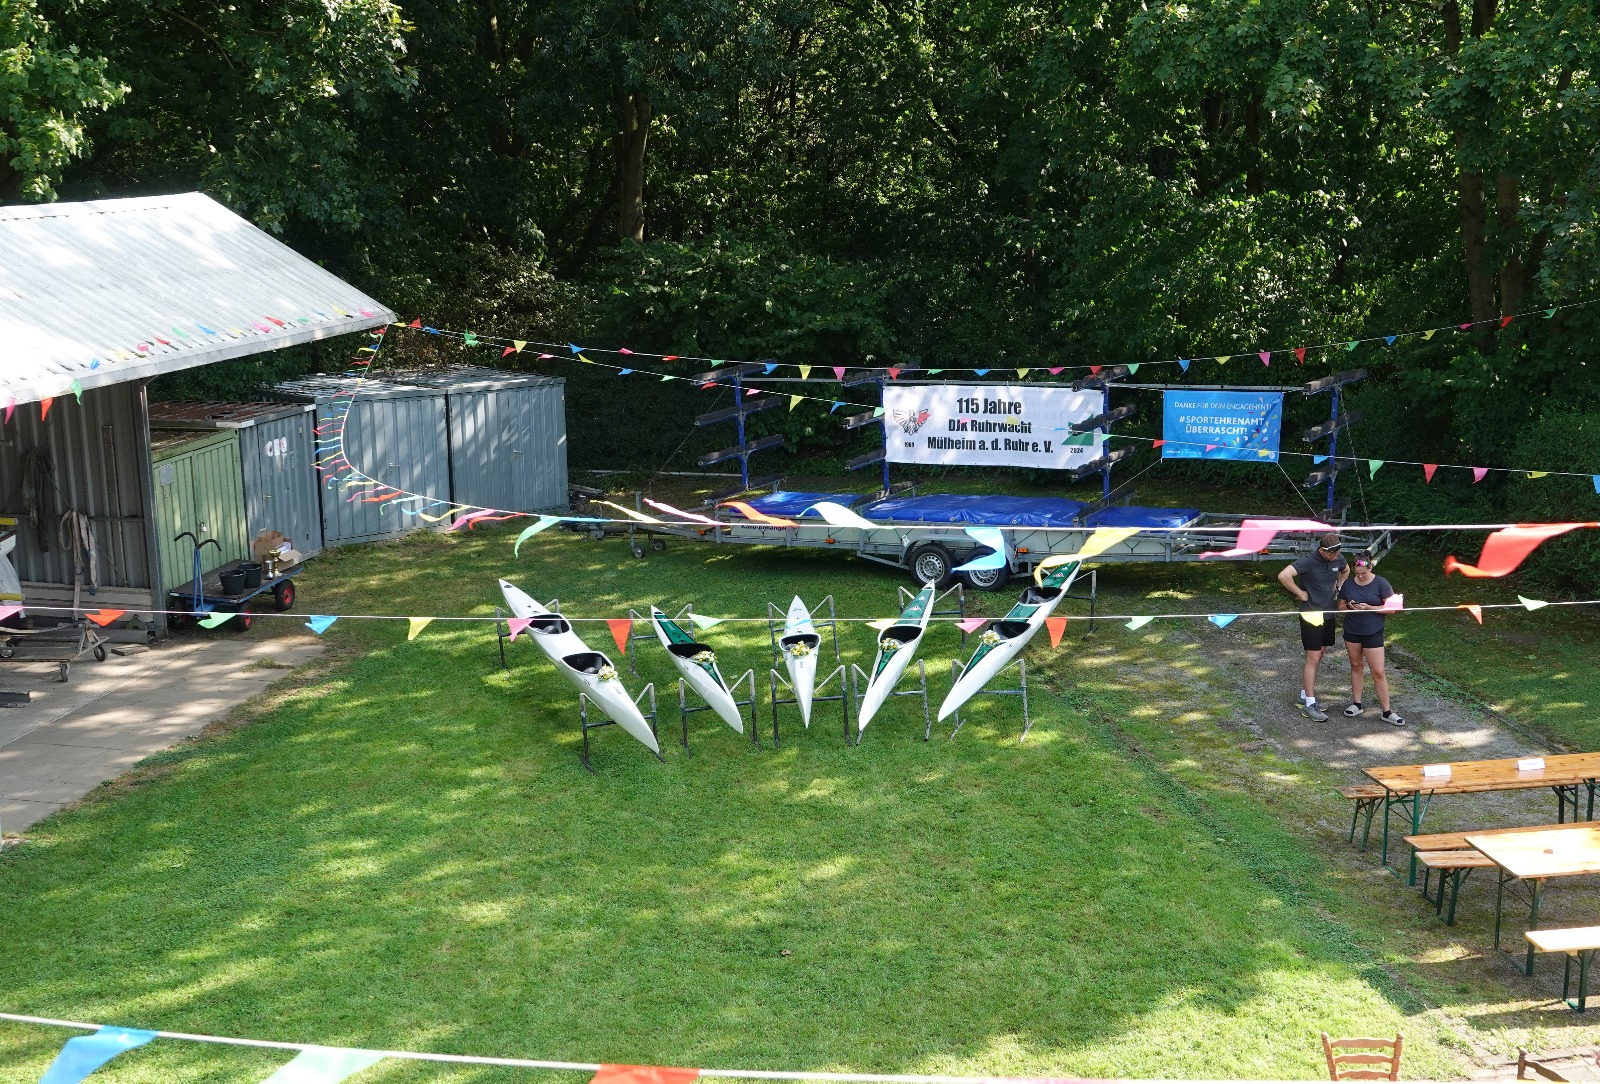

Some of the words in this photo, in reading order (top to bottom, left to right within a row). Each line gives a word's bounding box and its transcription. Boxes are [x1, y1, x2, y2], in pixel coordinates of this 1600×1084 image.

[956, 397, 980, 414] 115
[982, 398, 1022, 415] Jahre
[1174, 401, 1196, 409] DANKE
[1226, 403, 1272, 411] ENGAGEMENT!
[948, 418, 968, 432] DJK
[970, 419, 1032, 434] Ruhrwacht
[1178, 415, 1264, 426] #SPORTEHRENAMT
[1185, 424, 1248, 435] ÜBERRASCHT!
[927, 436, 976, 450] Mülheim
[978, 439, 989, 451] a.
[991, 438, 1002, 451] d.
[1004, 438, 1030, 452] Ruhr
[1031, 441, 1042, 453] e.
[1043, 440, 1054, 454] V.
